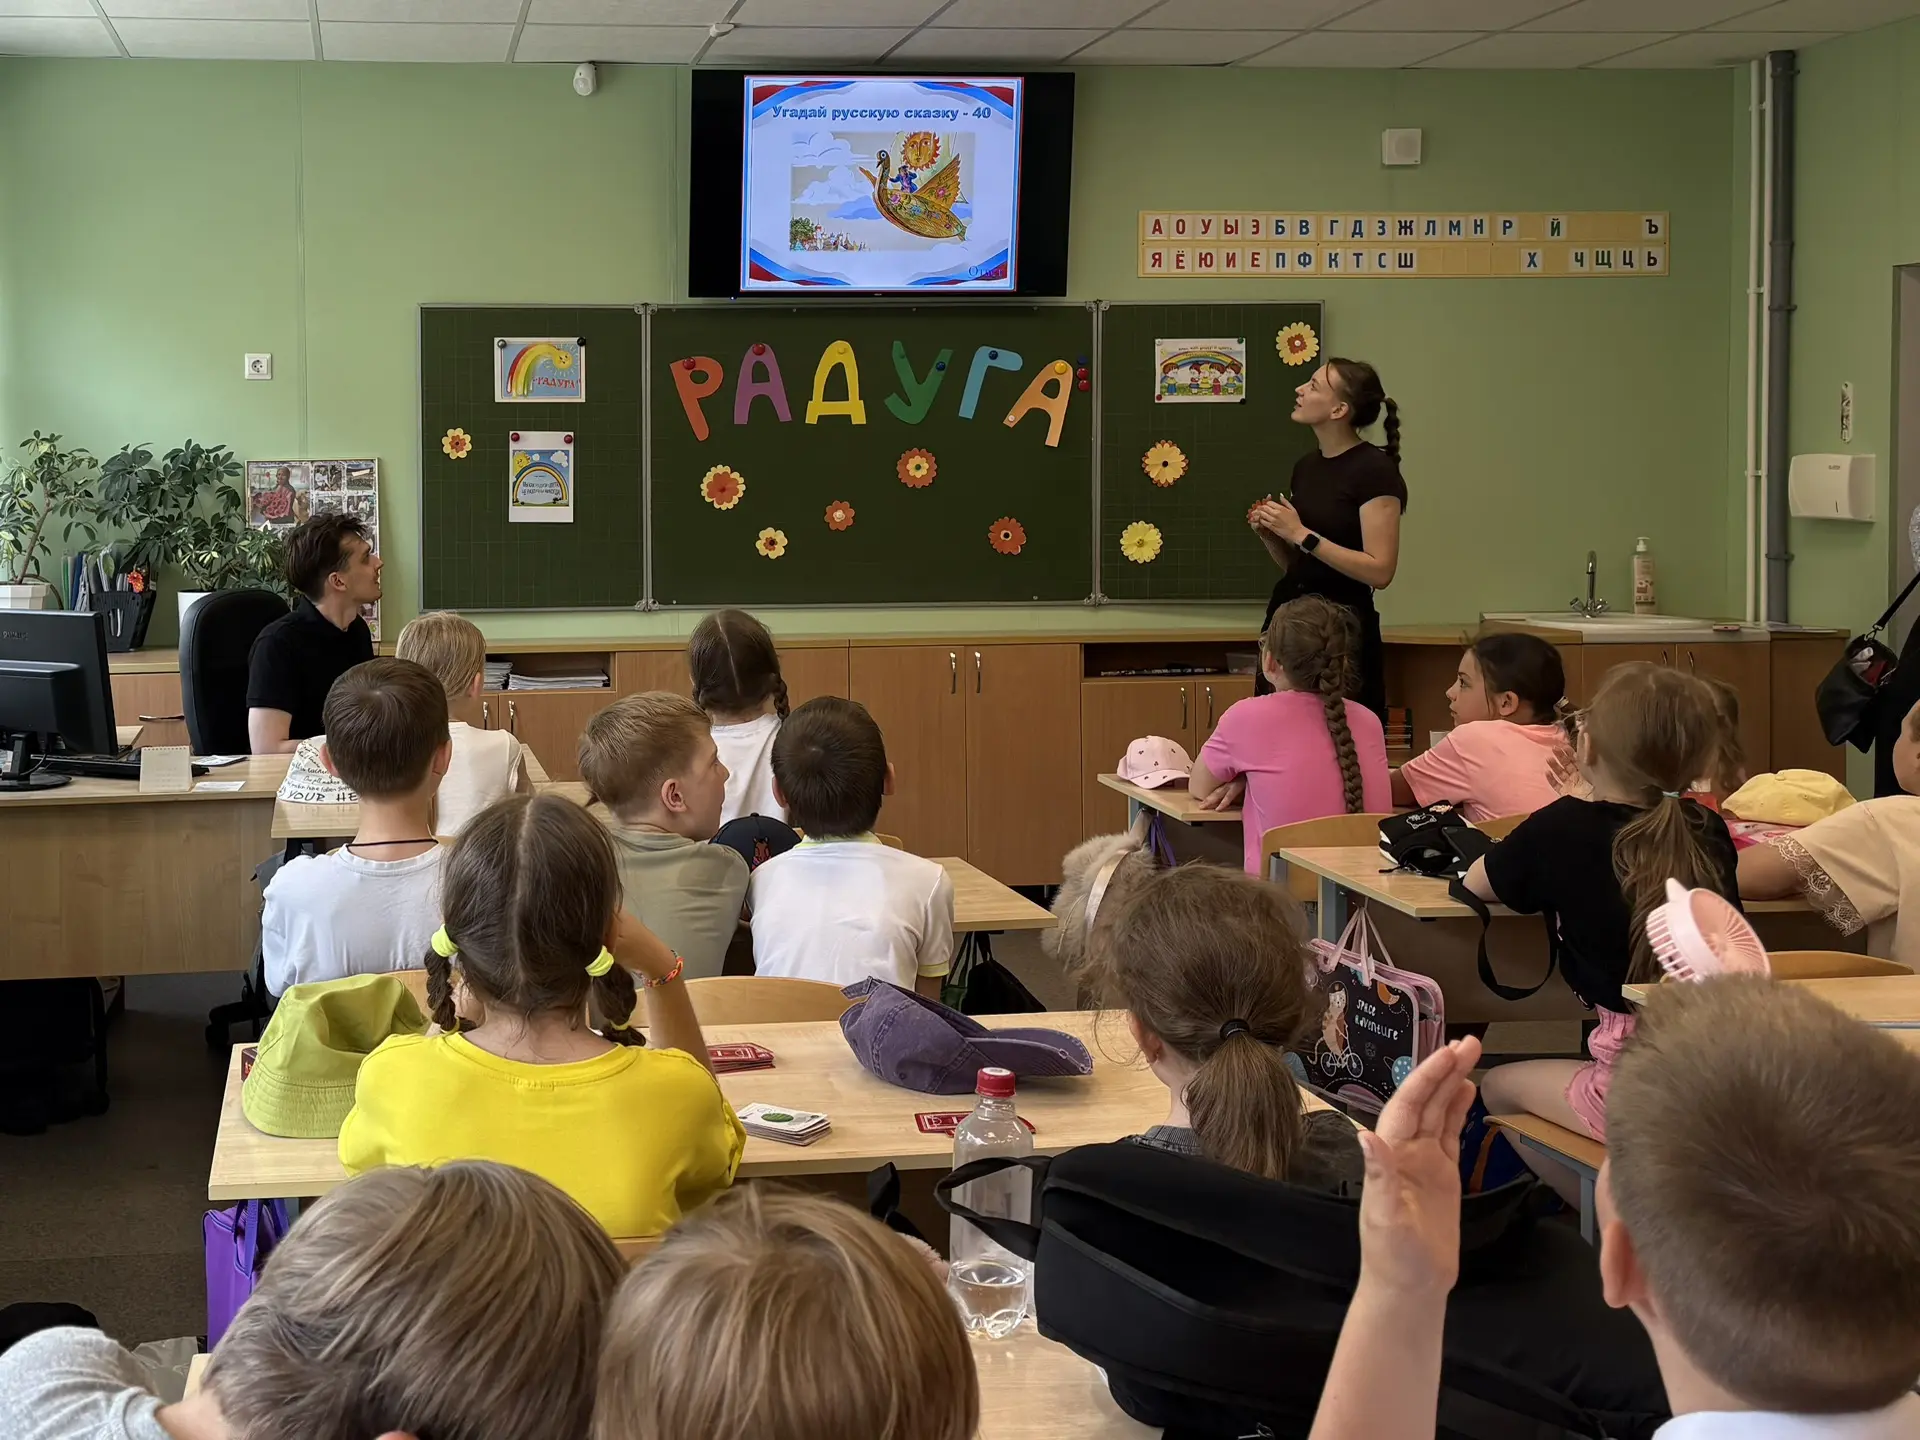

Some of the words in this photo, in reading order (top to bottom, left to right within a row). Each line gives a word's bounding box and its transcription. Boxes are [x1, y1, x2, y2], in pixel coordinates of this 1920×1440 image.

[772, 105, 827, 120] Угадай
[831, 108, 900, 121] русскую
[903, 108, 959, 122] сказку
[972, 107, 992, 119] 40
[1152, 219, 1163, 235] А
[1175, 219, 1186, 235] О
[1201, 219, 1212, 235] У
[1224, 219, 1239, 235] Ы
[1251, 219, 1260, 235] Э
[1275, 219, 1286, 235] Б
[1299, 219, 1310, 235] В
[1329, 219, 1339, 235] Г
[1351, 219, 1364, 238] Д
[1377, 219, 1386, 235] З
[1398, 219, 1415, 236] Ж
[1425, 219, 1436, 236] Л
[1449, 220, 1461, 236] М
[1473, 219, 1484, 235] Н
[1503, 219, 1513, 236] Р
[1550, 217, 1561, 237] Й
[1646, 219, 1659, 235] Ъ
[1151, 252, 1162, 268] Я
[1175, 250, 1186, 270] Ё
[1198, 252, 1214, 268] Ю
[1226, 252, 1237, 268] И
[1251, 252, 1261, 268] Е
[1275, 252, 1286, 268] П
[1297, 252, 1312, 268] Ф
[1329, 252, 1339, 269] К
[1353, 252, 1364, 268] Т
[1377, 252, 1387, 269] С
[1397, 252, 1414, 269] Ш
[1526, 252, 1538, 268] Х
[1574, 252, 1584, 268] Ч
[1595, 251, 1612, 269] Щ
[1622, 251, 1634, 269] Ц
[1647, 251, 1658, 267] Ь
[669, 340, 1074, 447] РАДУГА
[287, 791, 326, 802] YOUR
